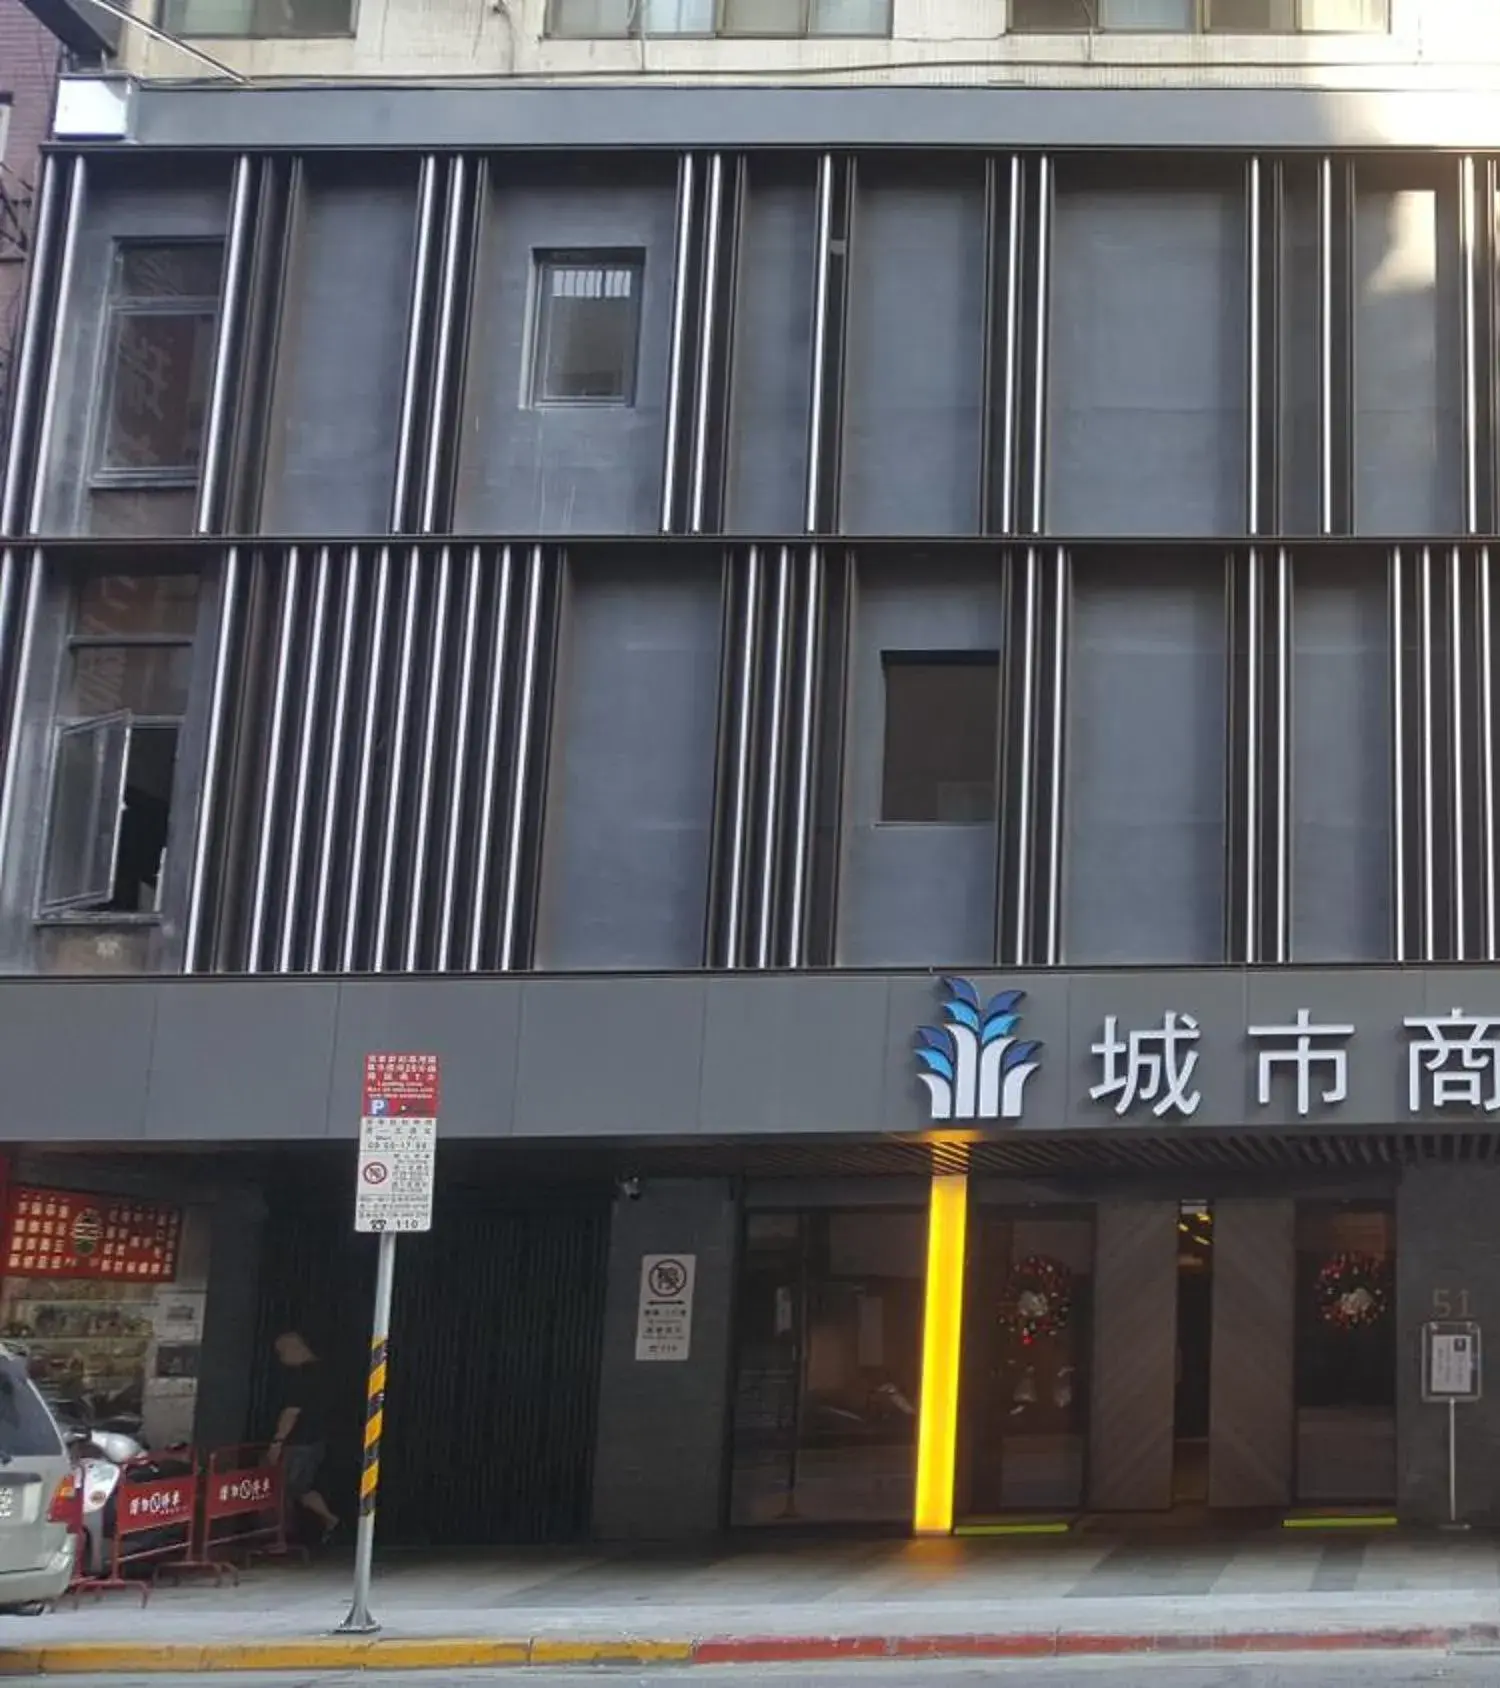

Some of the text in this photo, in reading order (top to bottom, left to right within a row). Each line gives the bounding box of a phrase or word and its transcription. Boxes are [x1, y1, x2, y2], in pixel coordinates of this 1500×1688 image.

[372, 1100, 385, 1114] P
[396, 1219, 419, 1229] 110
[1433, 1289, 1475, 1317] 51
